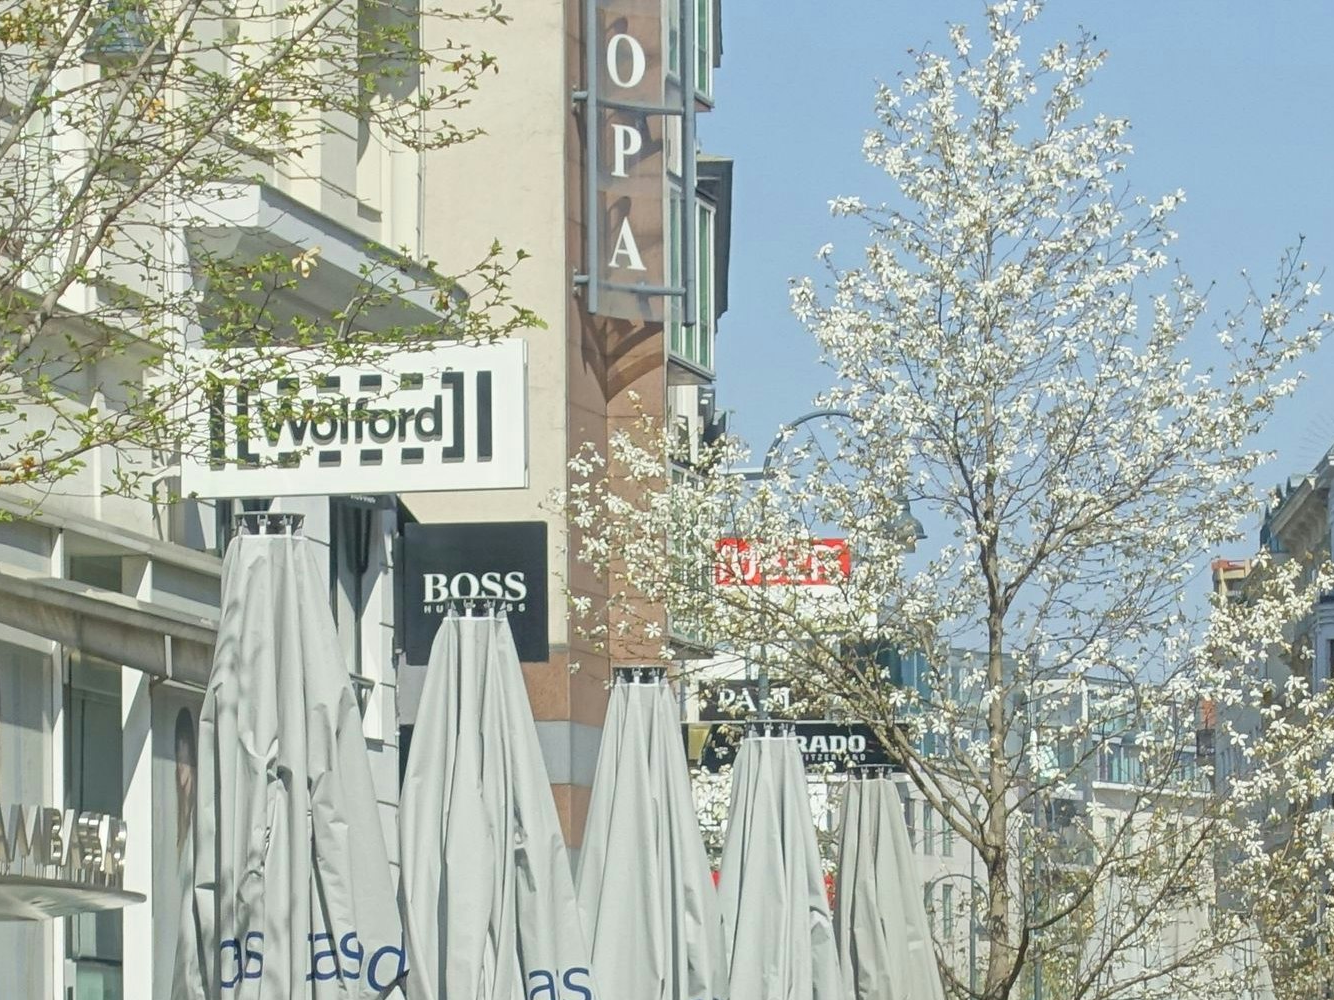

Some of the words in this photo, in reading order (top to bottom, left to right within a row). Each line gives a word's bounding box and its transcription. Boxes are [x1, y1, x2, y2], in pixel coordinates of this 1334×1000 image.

[257, 395, 443, 447] Wolford
[423, 571, 527, 602] BOSS
[796, 735, 866, 753] RADO
